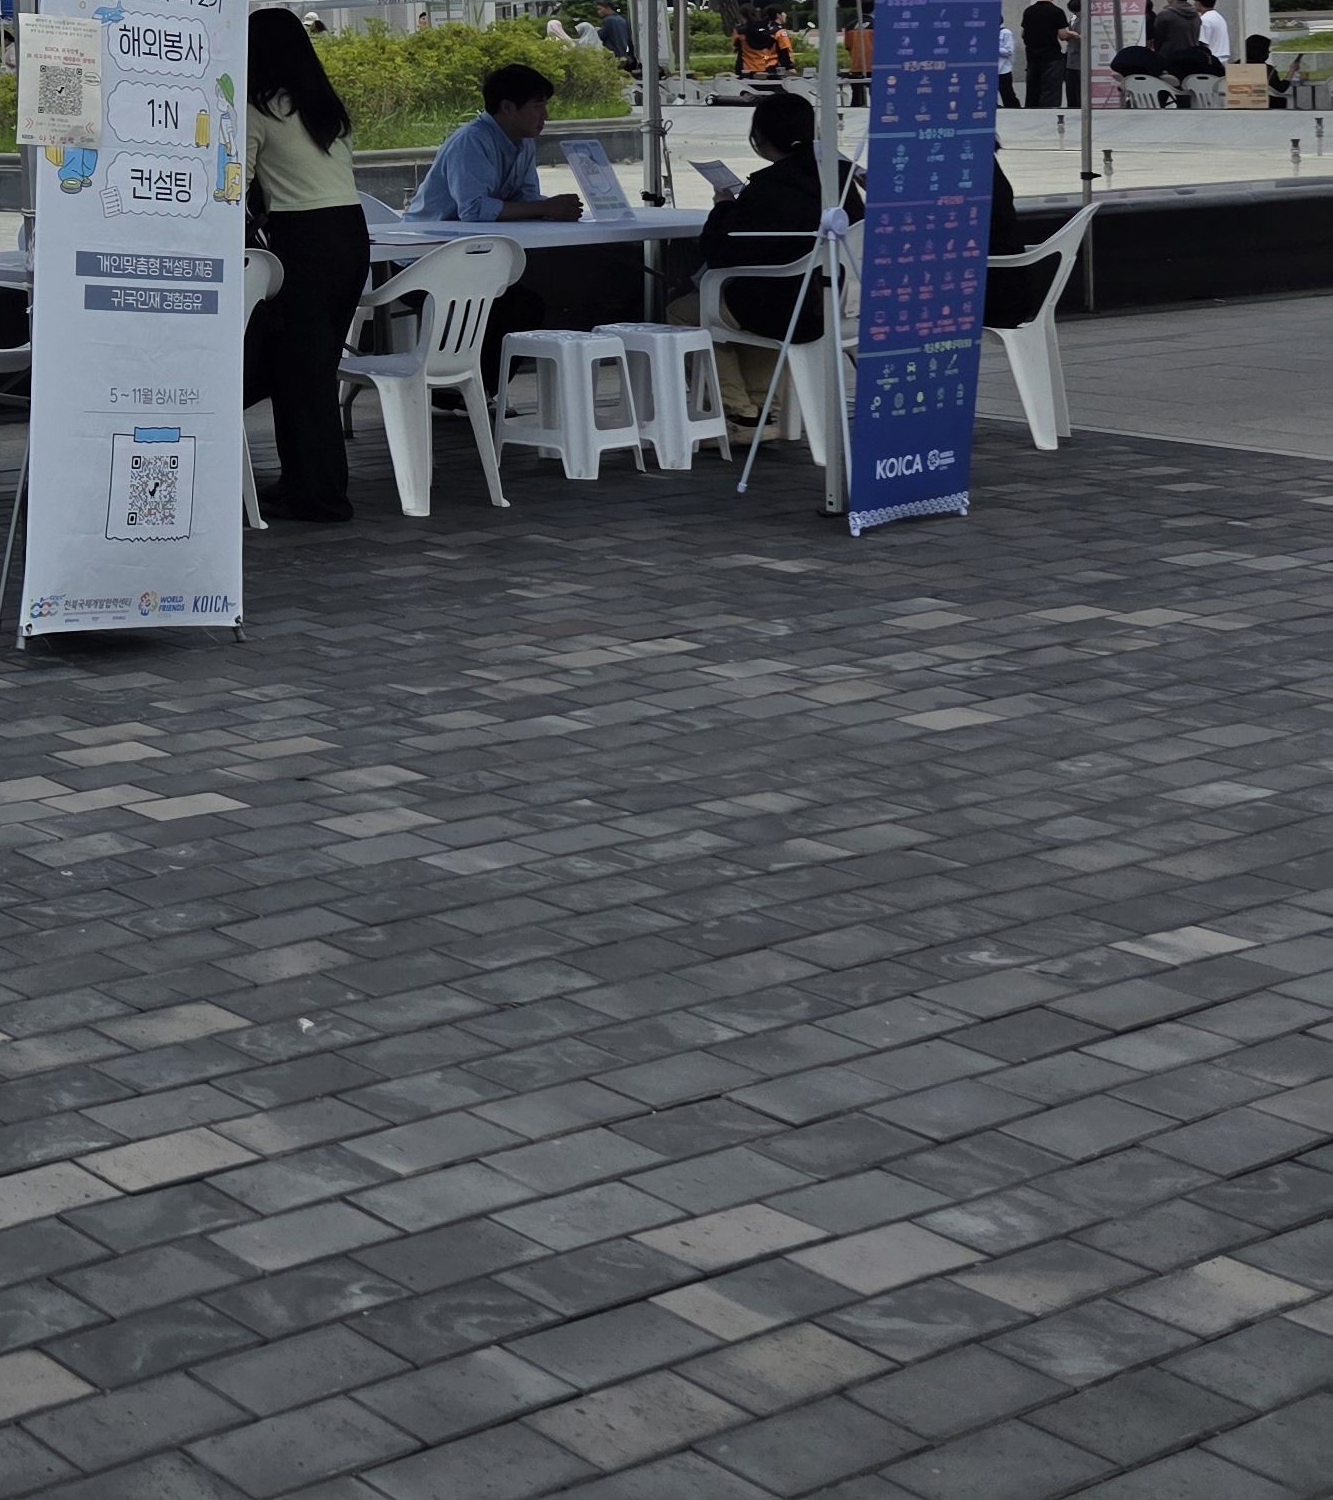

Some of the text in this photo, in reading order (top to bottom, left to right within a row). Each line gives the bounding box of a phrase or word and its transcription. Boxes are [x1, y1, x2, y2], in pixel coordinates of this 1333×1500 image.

[119, 24, 203, 65] 해외봉사
[147, 98, 179, 129] 1:N
[130, 168, 192, 203] 컨설팅
[96, 256, 213, 278] 개인맞춤형 컨설팅 제공
[110, 289, 203, 311] 귀국인재 경험공유
[155, 388, 176, 405] 상시
[876, 453, 923, 480] KOICA
[158, 603, 185, 612] FRIENDS
[160, 595, 184, 604] WORLD
[192, 595, 229, 613] KOICA
